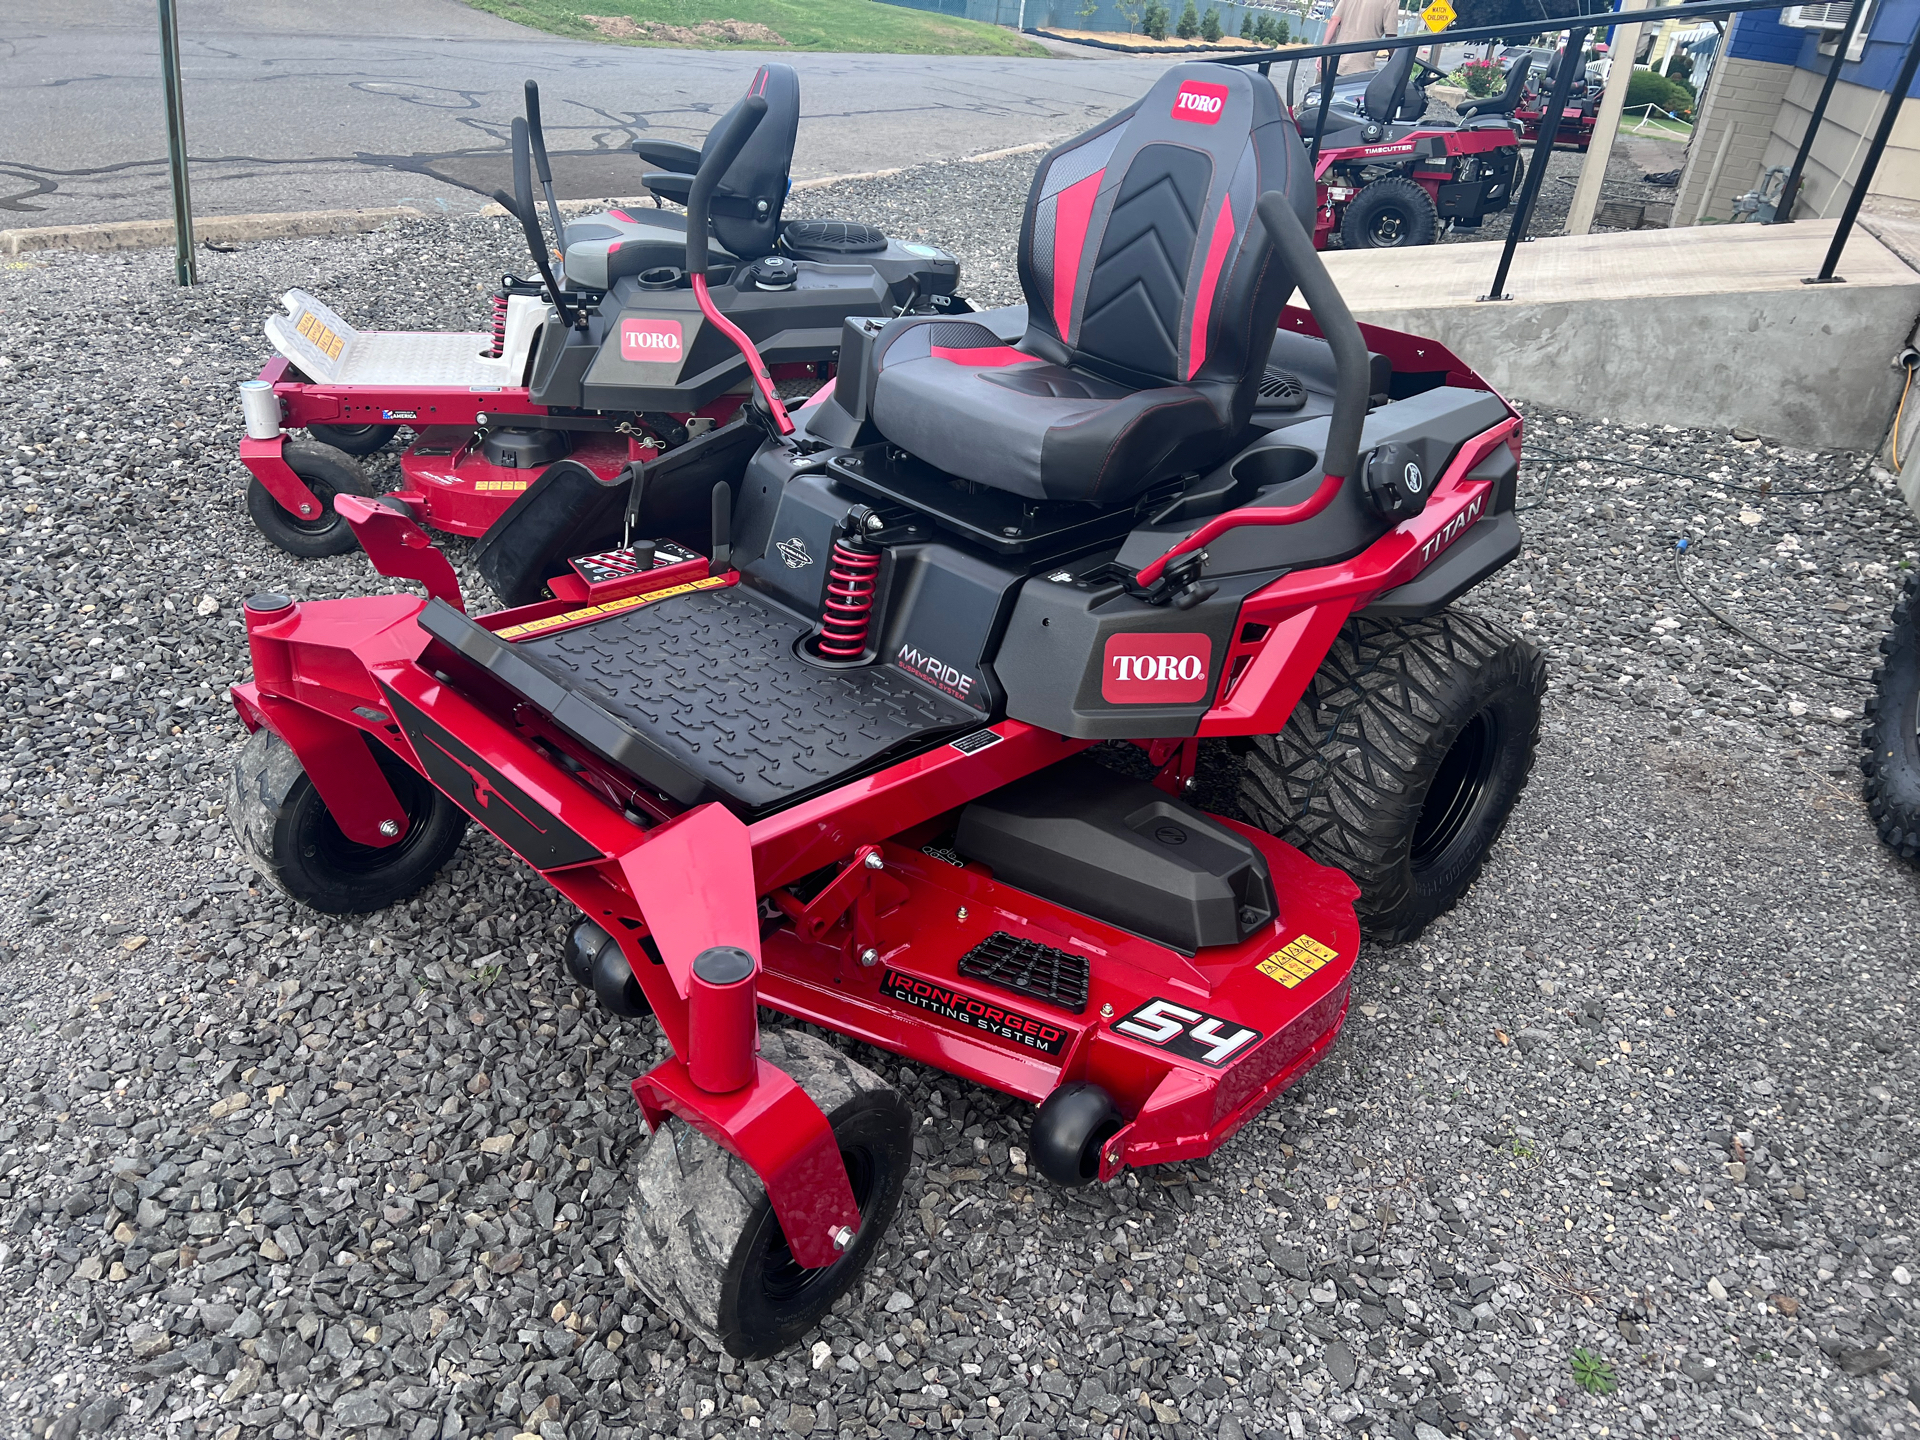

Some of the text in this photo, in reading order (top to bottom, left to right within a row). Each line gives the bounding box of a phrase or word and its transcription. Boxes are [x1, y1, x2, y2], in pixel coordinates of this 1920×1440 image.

[1178, 92, 1222, 113] TORO
[1365, 144, 1412, 154] TIMECUTTER
[626, 331, 678, 349] TORO
[1422, 495, 1482, 562] TITAN
[898, 661, 965, 700] SUSPENSION SYSTEM
[1112, 655, 1202, 681] TORO
[888, 971, 1061, 1042] IRONFORGED
[895, 990, 1049, 1051] CUTTING SYSTEM
[1116, 1000, 1257, 1065] 54
